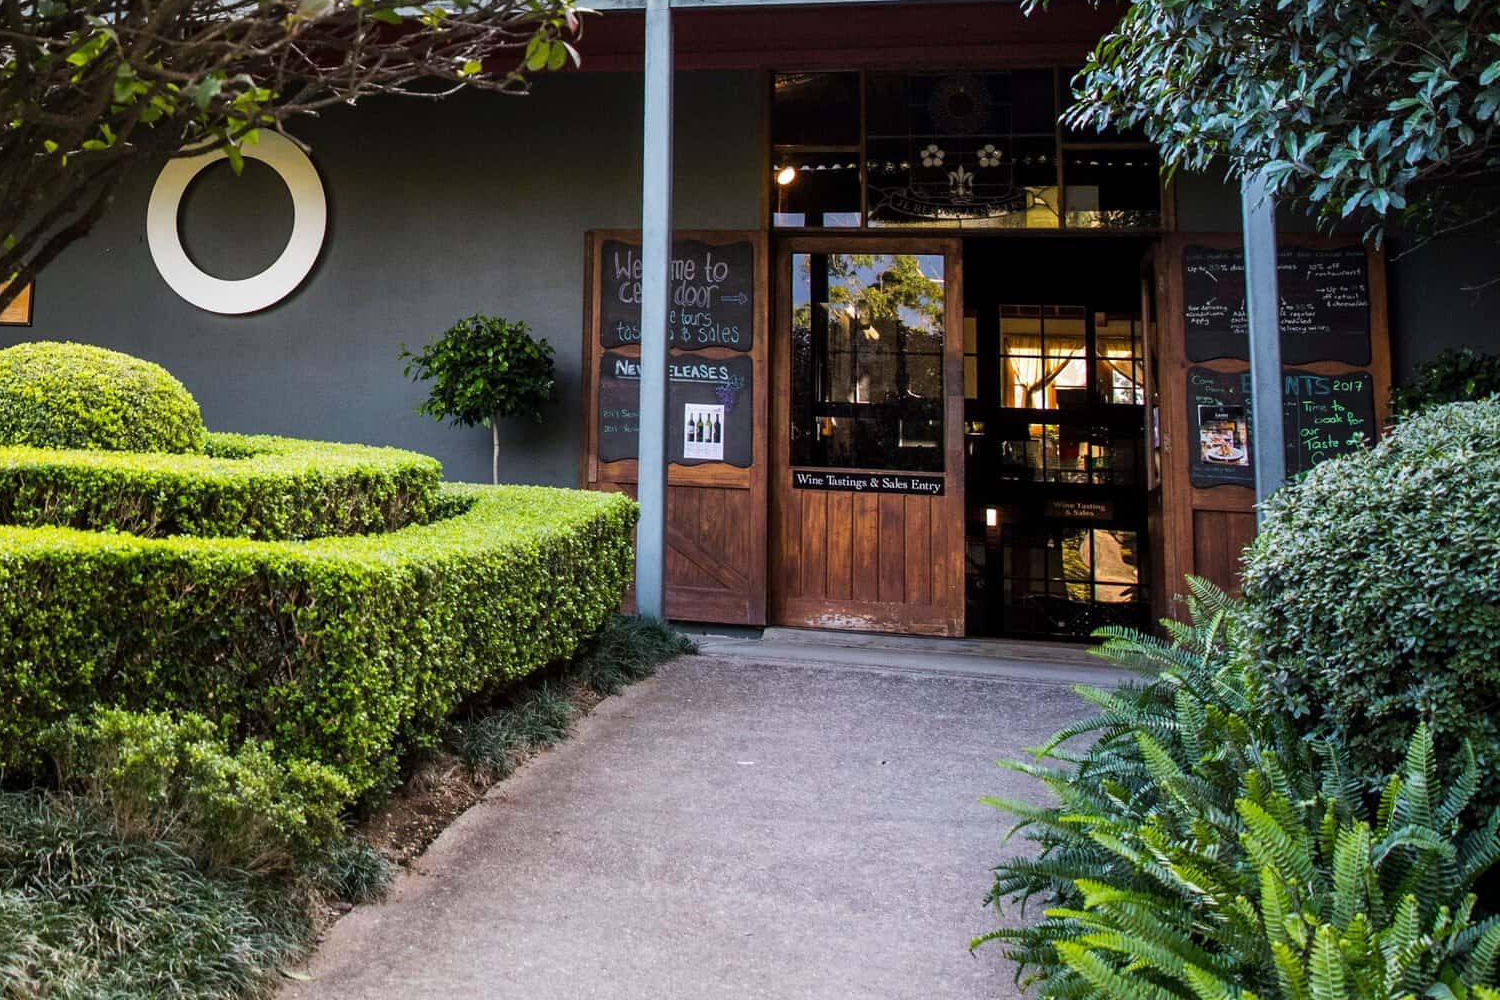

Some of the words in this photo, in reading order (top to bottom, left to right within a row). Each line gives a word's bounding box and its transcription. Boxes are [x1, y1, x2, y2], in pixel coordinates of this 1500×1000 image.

[614, 250, 696, 281] Weme
[704, 251, 729, 283] to
[674, 281, 719, 309] door
[681, 308, 712, 328] tours
[697, 322, 741, 344] sales
[1333, 380, 1363, 393] 2017
[1331, 399, 1346, 412] to
[1300, 427, 1320, 437] our
[1302, 433, 1339, 451] Taste
[797, 473, 824, 486] Wine
[825, 474, 867, 490] Tastings
[869, 477, 880, 489] &
[882, 477, 908, 490] Sales
[911, 479, 941, 494] Entry
